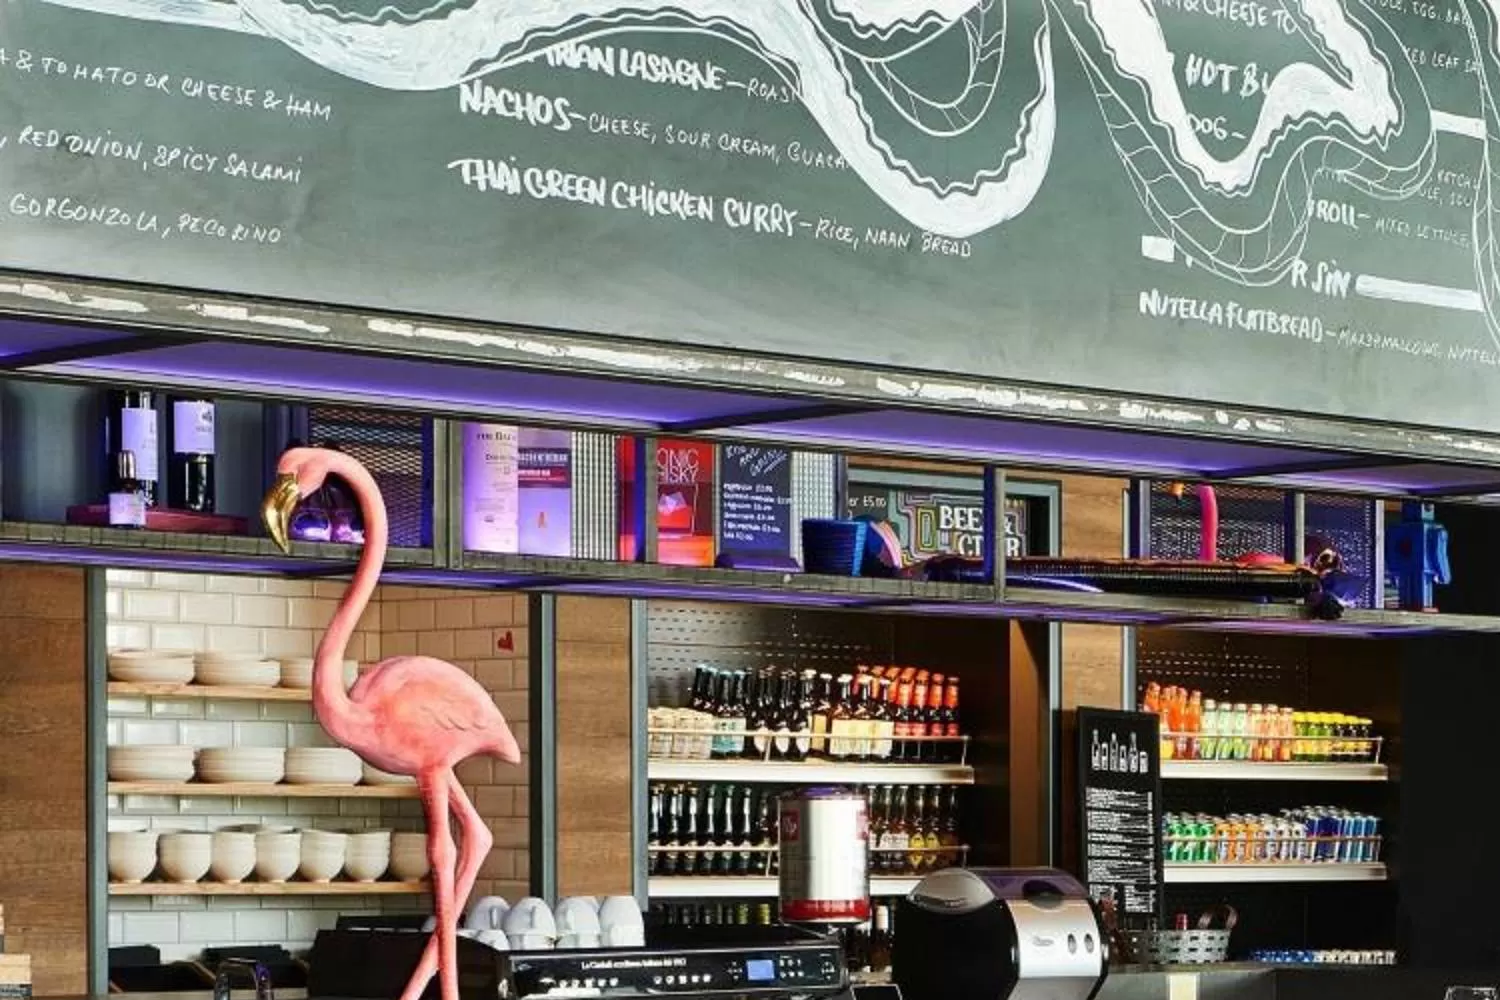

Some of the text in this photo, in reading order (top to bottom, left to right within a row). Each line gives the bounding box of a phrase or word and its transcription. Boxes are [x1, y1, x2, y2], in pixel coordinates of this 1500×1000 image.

[42, 56, 137, 86] TOMATO
[145, 73, 170, 94] OR
[181, 75, 256, 107] CHEESE
[286, 92, 331, 121] HAM
[1185, 53, 1239, 95] HOT
[19, 125, 59, 148] RED
[152, 145, 218, 172] SPICY
[223, 153, 303, 184] SALAMI
[665, 124, 711, 148] SOUR
[718, 133, 780, 164] CREAM,
[787, 141, 851, 169] GUACA
[447, 155, 522, 195] THAI
[523, 167, 608, 207] GREEN
[611, 180, 714, 222] CHICKEN
[865, 227, 911, 248] NAAN
[921, 231, 972, 257] BREAD
[177, 213, 281, 244] PECORINO
[1138, 287, 1223, 328] NUTELLA
[938, 505, 985, 530] BEE
